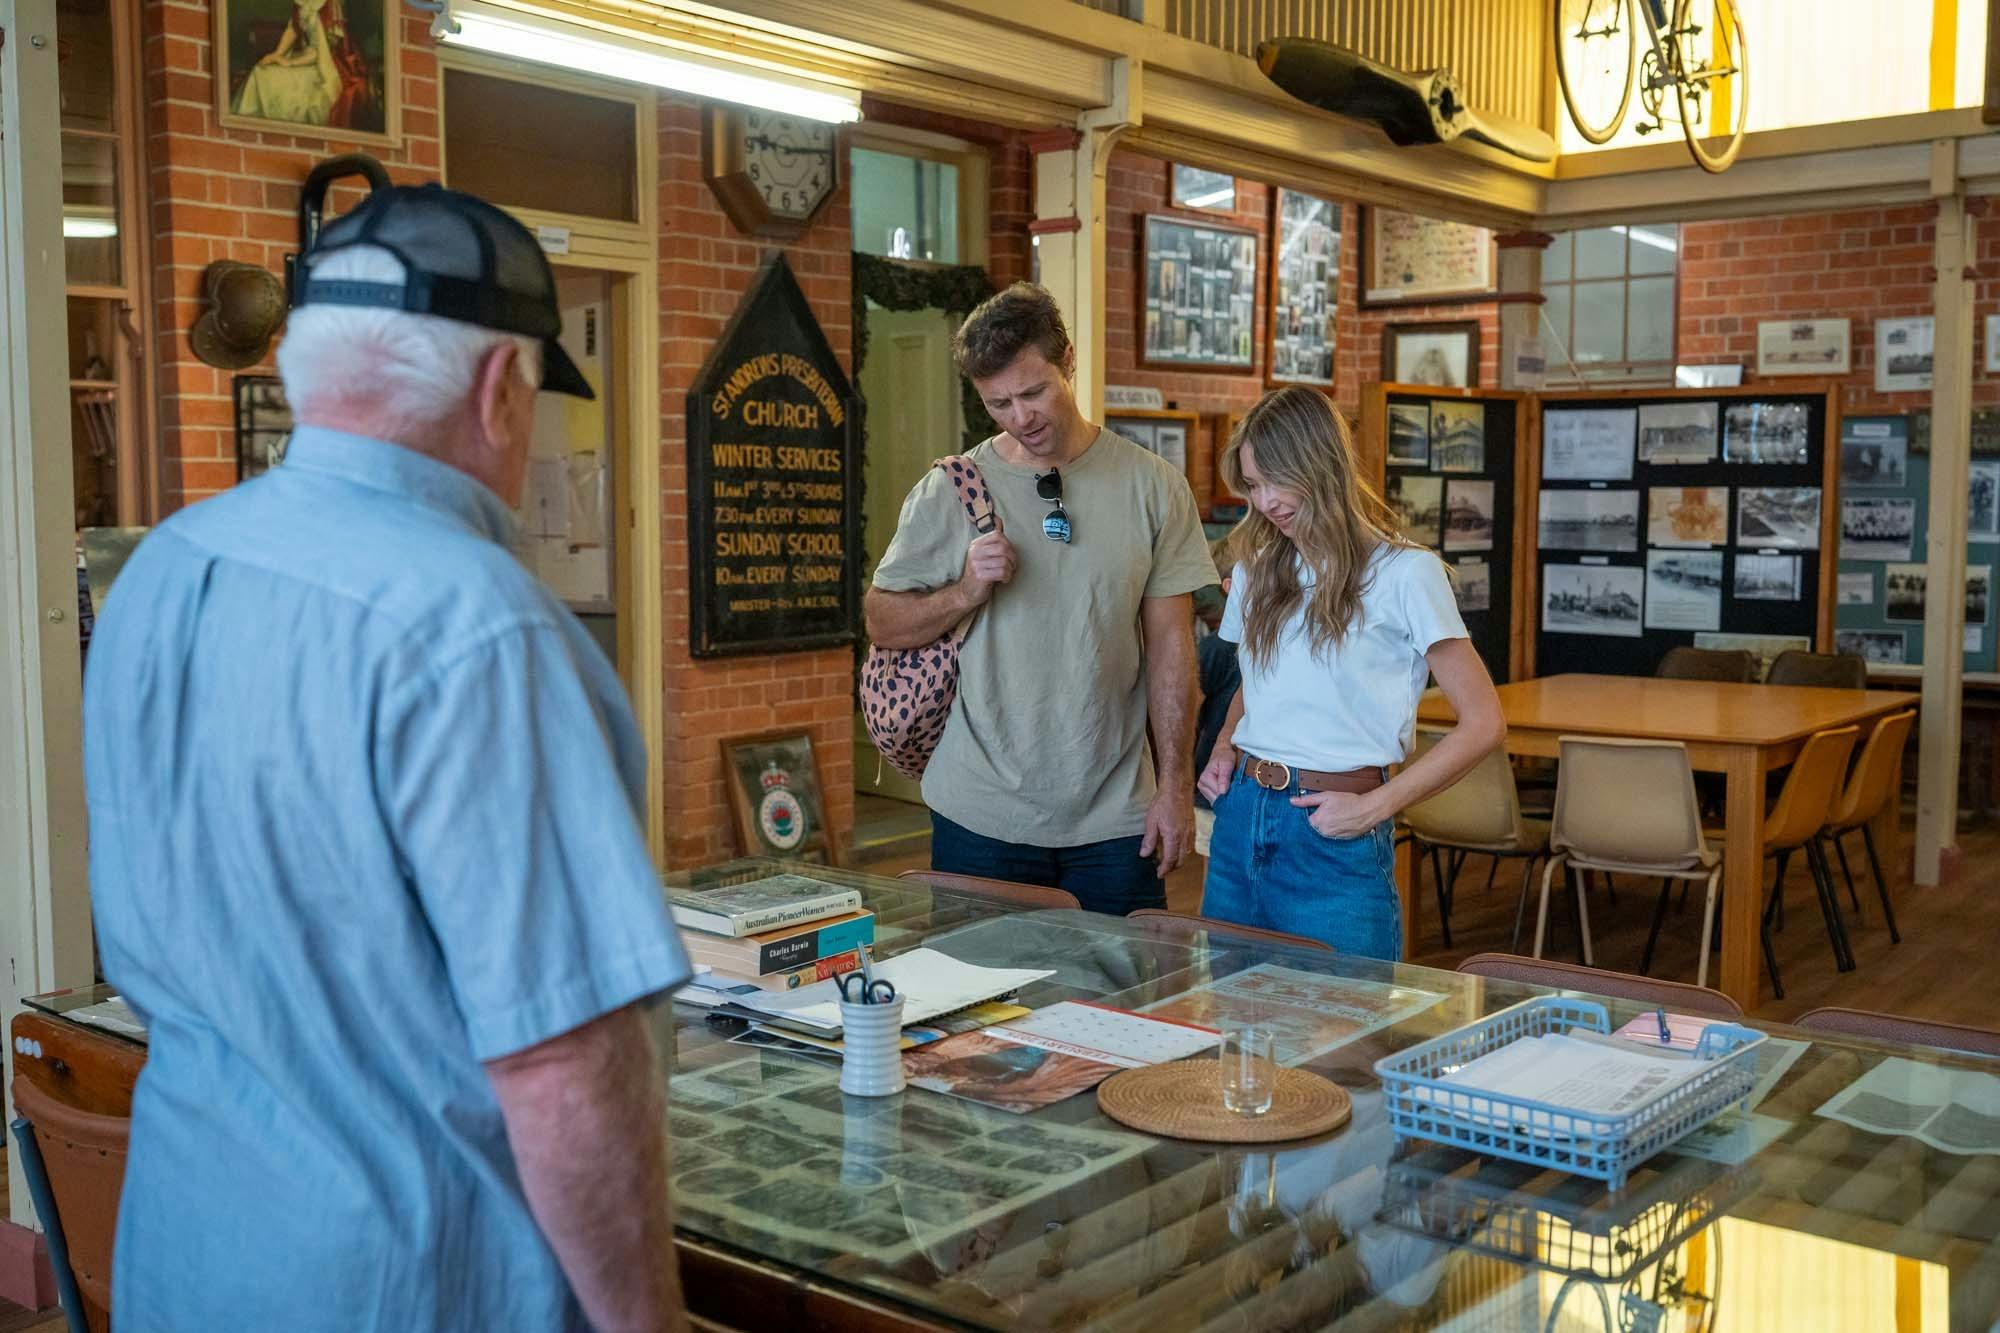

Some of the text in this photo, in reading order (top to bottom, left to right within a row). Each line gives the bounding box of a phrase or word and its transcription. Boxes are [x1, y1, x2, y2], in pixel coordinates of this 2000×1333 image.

[750, 162, 760, 181] 8
[764, 184, 773, 202] 7
[782, 191, 792, 209] 6
[799, 190, 809, 208] 5
[725, 353, 780, 402] ANDREWS
[781, 353, 844, 428] PRESBYTERIAN
[743, 399, 818, 429] CHURCH
[712, 443, 842, 472] WINTER SERVICES
[755, 507, 793, 524] EVERY
[797, 506, 842, 525] SUNDAY
[716, 531, 843, 557] SUNDAY SCHOOL
[746, 565, 787, 584] EVERY
[791, 565, 841, 583] SUNDAY
[744, 916, 778, 930] Australian
[777, 910, 803, 923] Pioneer
[801, 904, 826, 917] Women
[769, 947, 790, 959] Charles
[791, 941, 809, 952] Darwin
[1041, 1040, 1112, 1060] FEBRUARY
